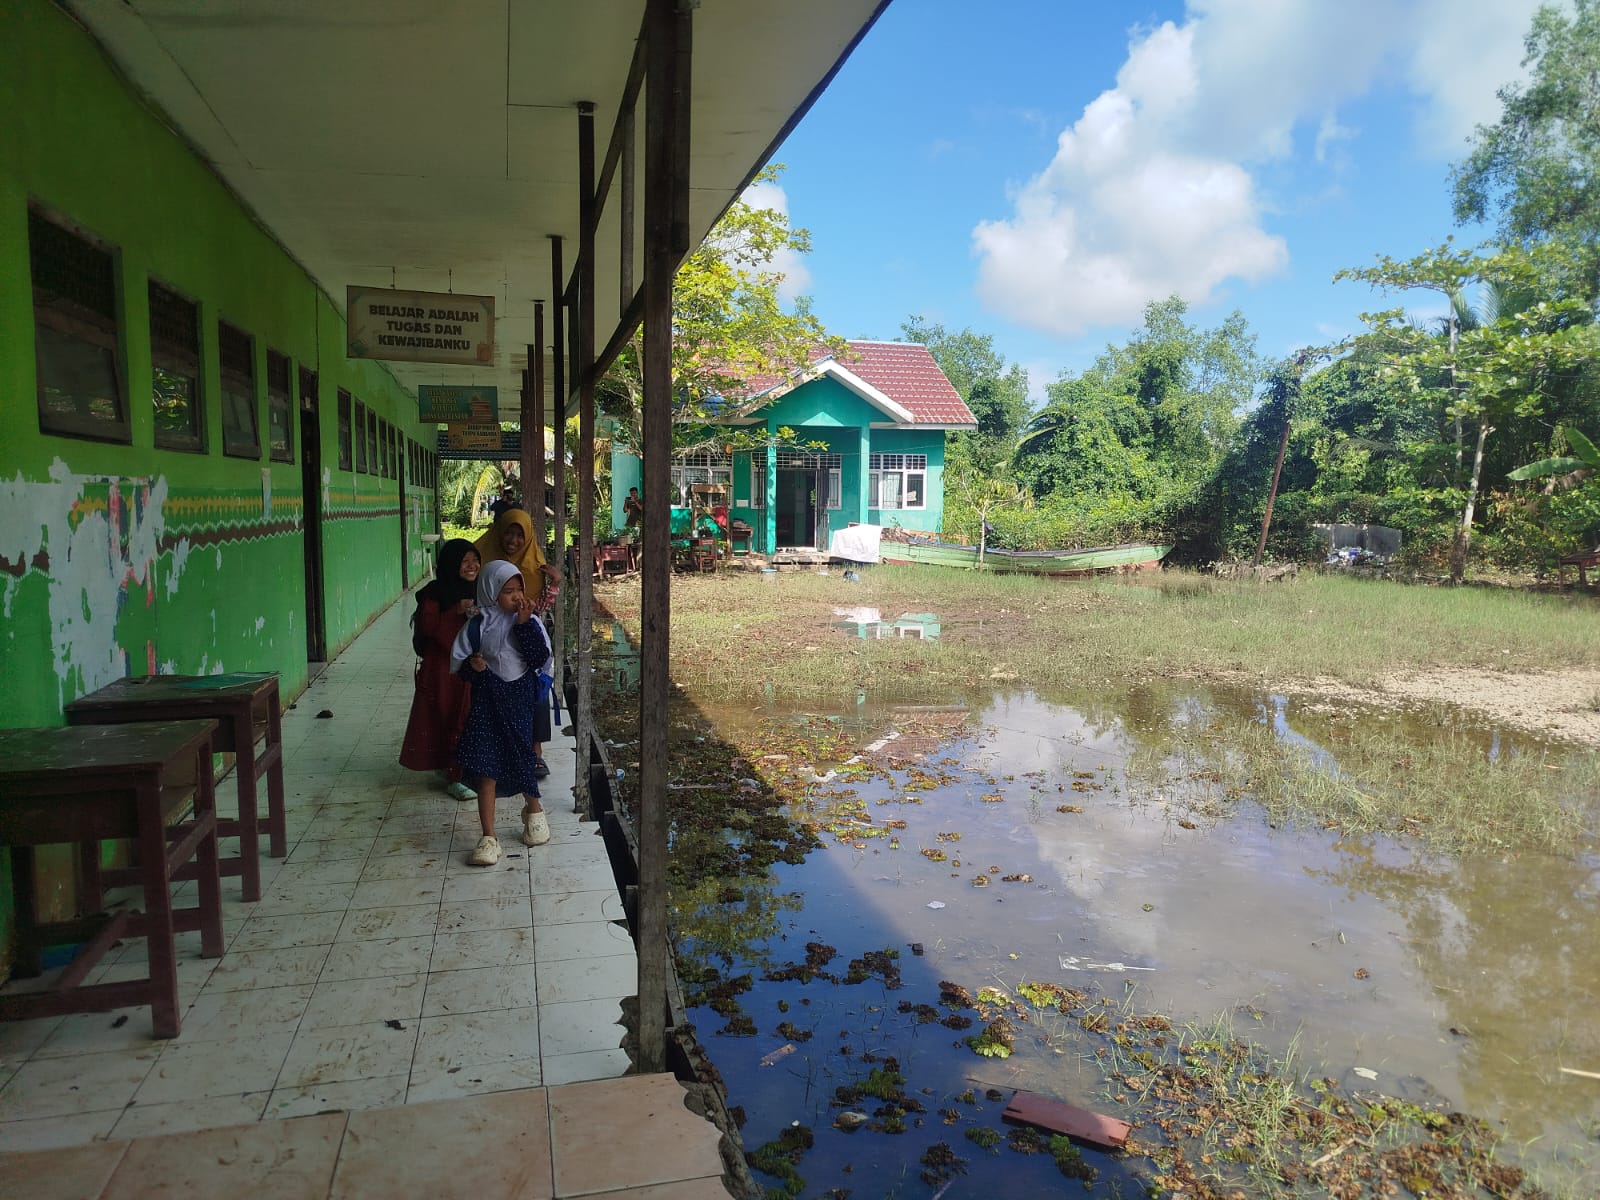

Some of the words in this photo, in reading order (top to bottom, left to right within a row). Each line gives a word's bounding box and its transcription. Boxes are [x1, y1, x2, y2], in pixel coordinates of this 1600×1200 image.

[369, 304, 425, 319] BELAJAR
[428, 308, 480, 322] ADALAH
[386, 320, 431, 334] TUGAS
[434, 324, 462, 335] DAN
[378, 334, 471, 351] KEWAJIBANKU
